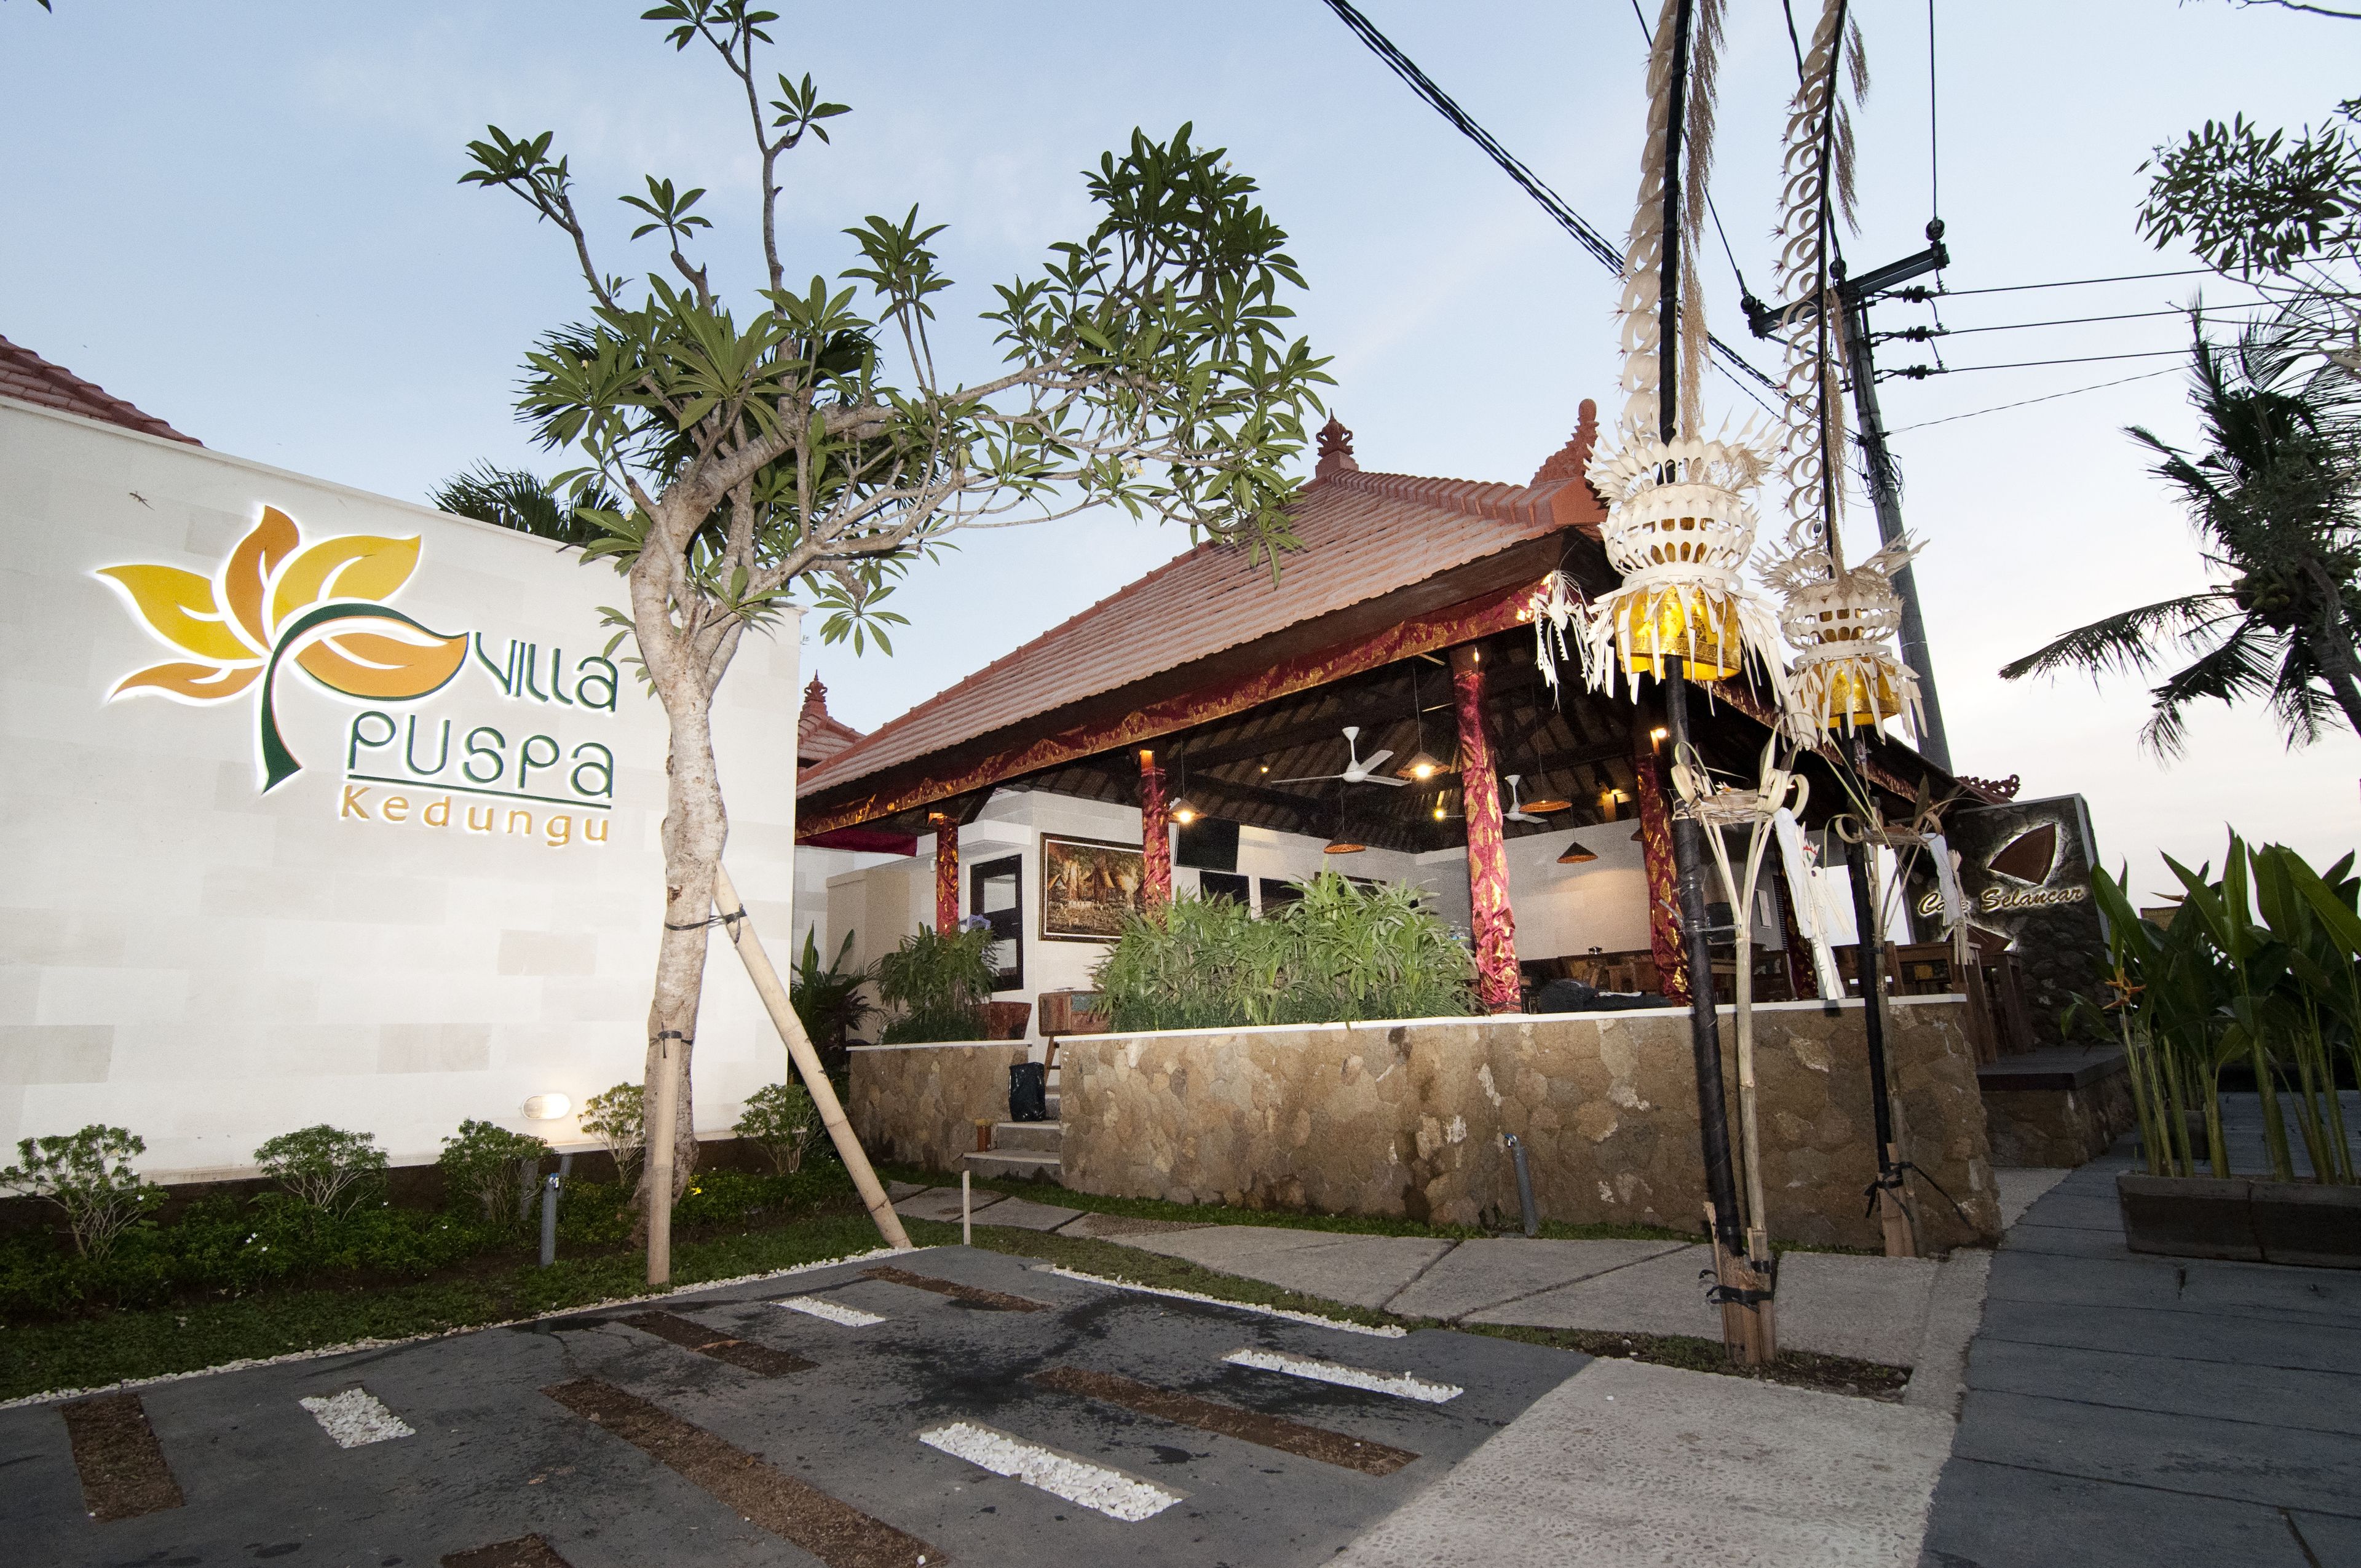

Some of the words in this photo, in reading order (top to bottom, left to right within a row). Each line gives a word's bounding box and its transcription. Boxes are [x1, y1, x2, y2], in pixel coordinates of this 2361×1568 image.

[341, 784, 609, 847] Kedungu
[1918, 892, 1971, 914] Ca
[1982, 889, 2084, 910] Selancar
